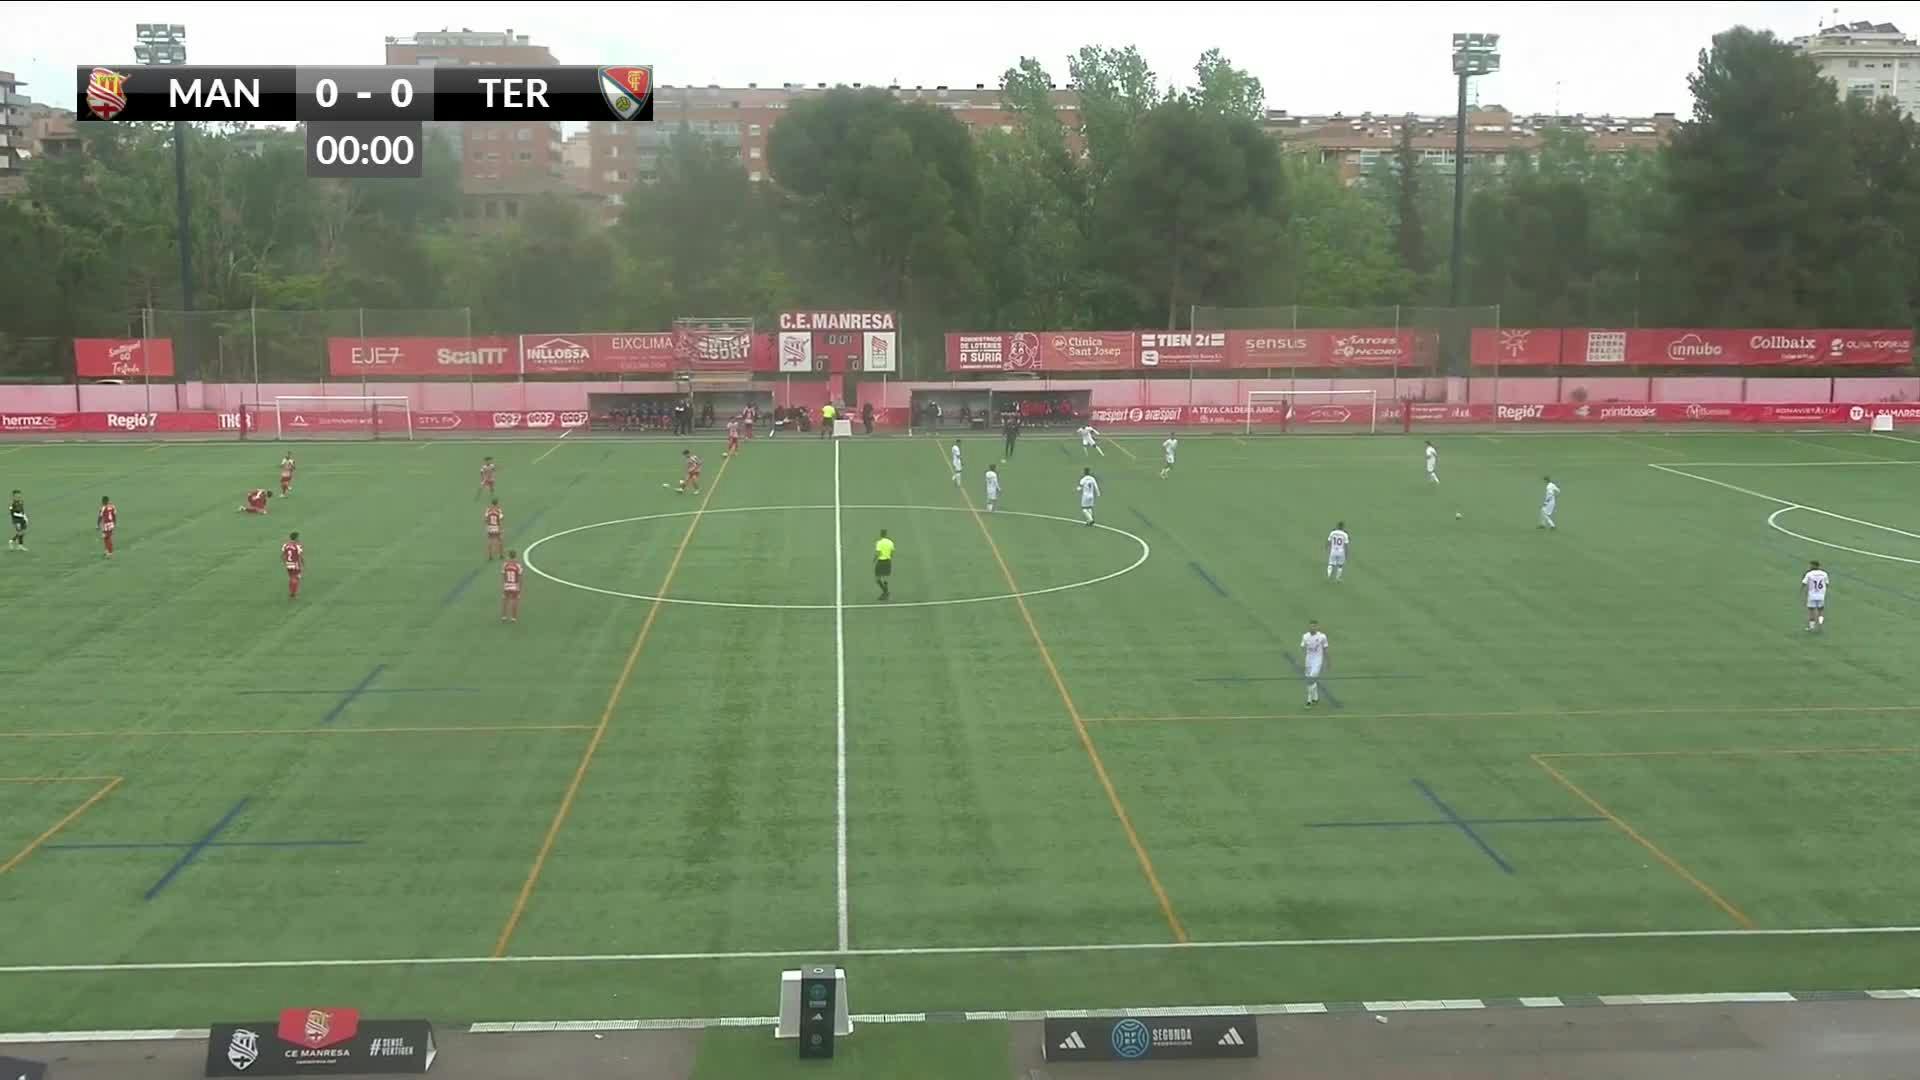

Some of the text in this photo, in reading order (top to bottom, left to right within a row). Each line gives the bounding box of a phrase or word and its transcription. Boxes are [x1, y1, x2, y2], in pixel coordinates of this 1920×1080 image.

[612, 338, 674, 350] EIXCLIMA
[1068, 336, 1103, 347] Clínica
[1157, 334, 1191, 347] TIEN
[1246, 339, 1307, 349] sensus
[1750, 335, 1816, 349] Collbaix
[1068, 346, 1121, 357] Sant Josep
[1332, 536, 1343, 546] 10
[1812, 580, 1824, 590] 16
[1152, 1028, 1192, 1041] SEGUNDA
[285, 1047, 351, 1057] CE MANRESA
